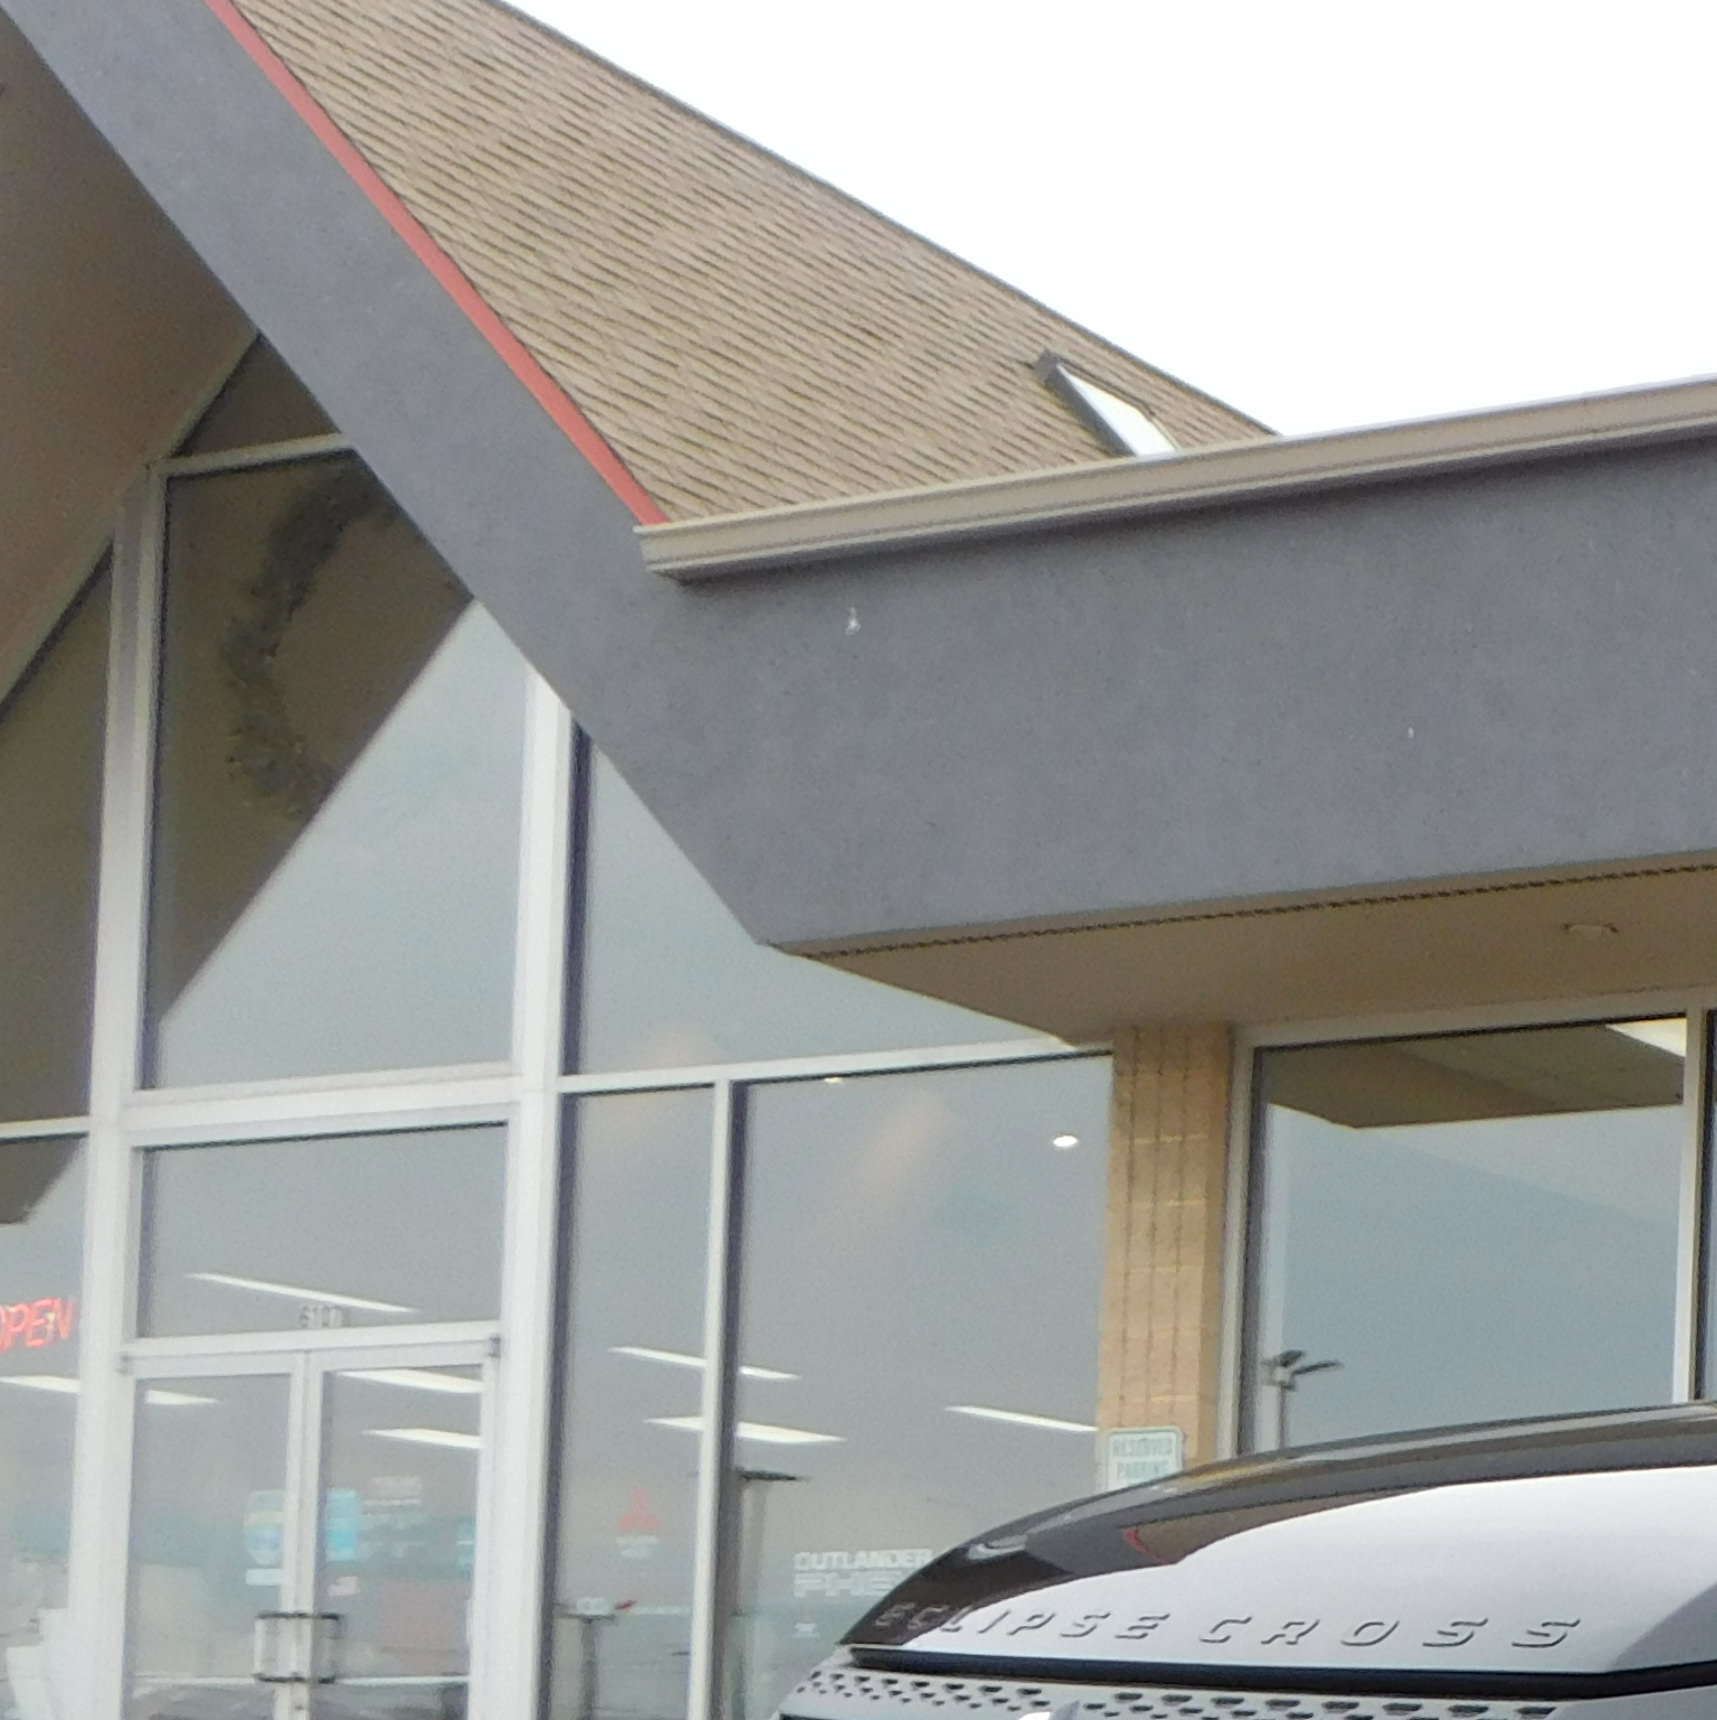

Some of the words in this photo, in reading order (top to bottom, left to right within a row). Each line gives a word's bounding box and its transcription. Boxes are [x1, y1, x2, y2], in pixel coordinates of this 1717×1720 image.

[793, 1549, 933, 1571] OUTLANDER
[793, 1570, 904, 1598] PHE
[873, 1600, 1169, 1640] ECLIPSE
[1198, 1617, 1583, 1649] CROSS
